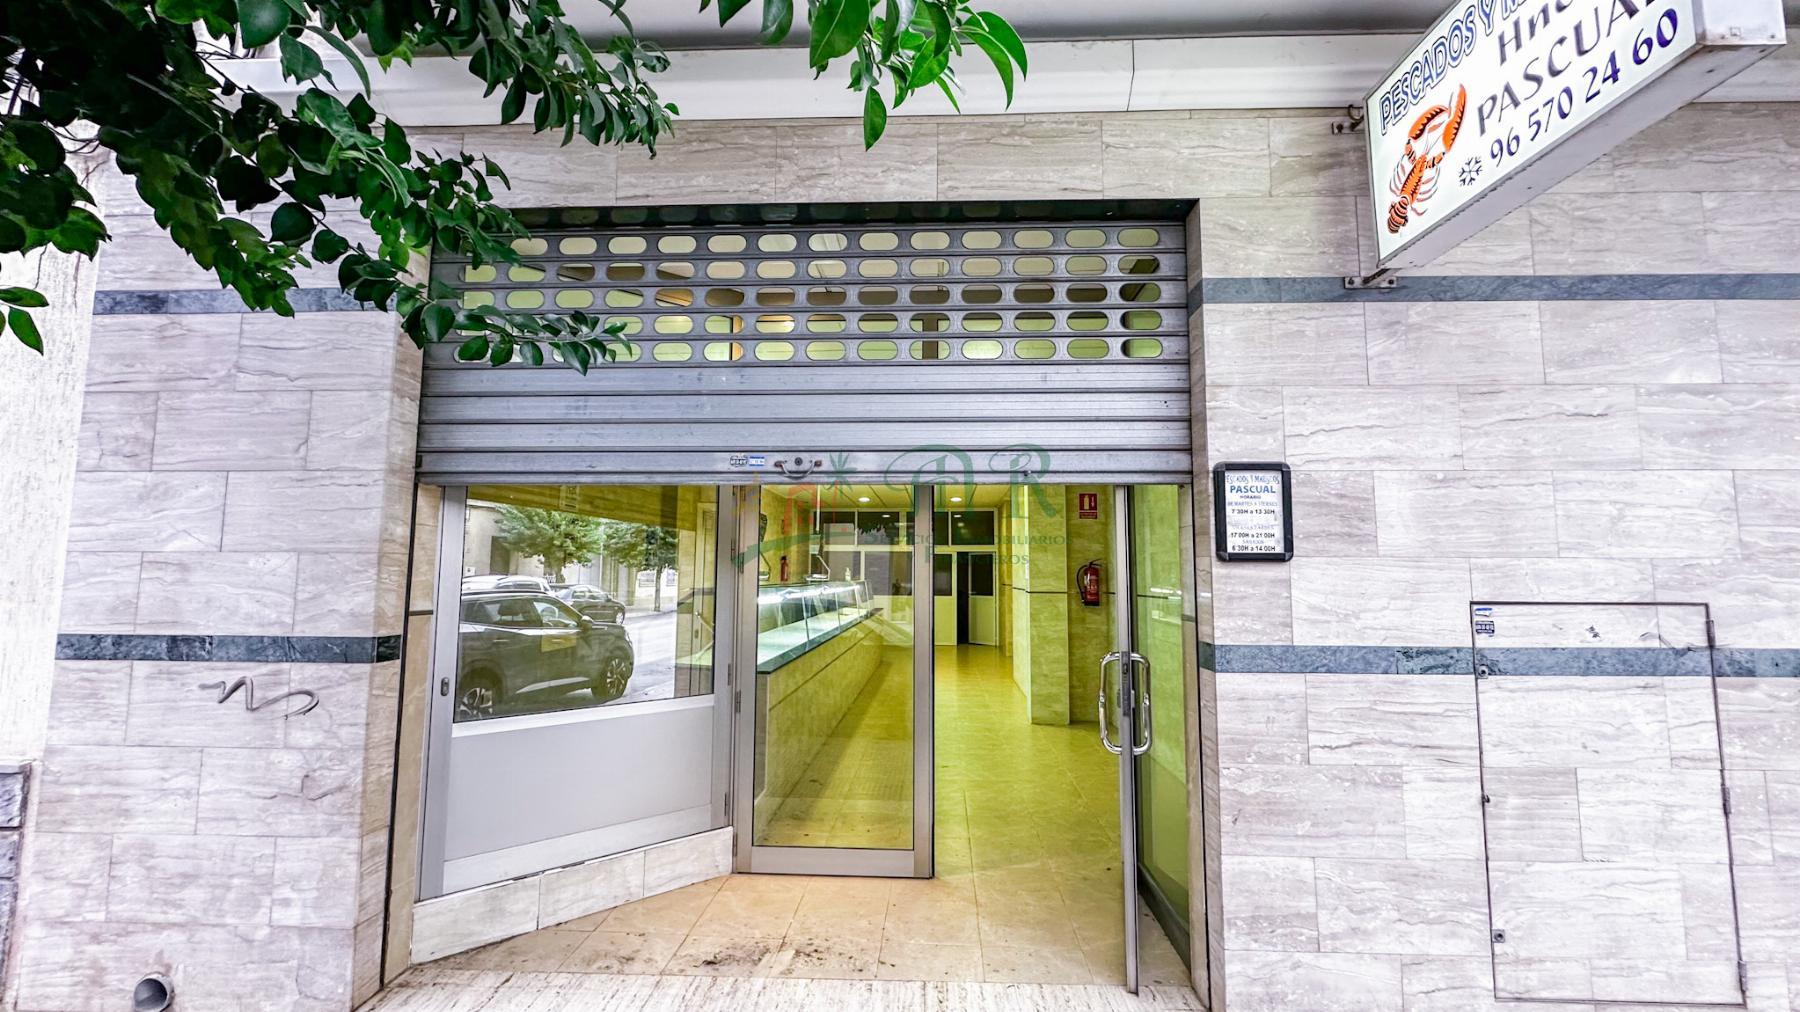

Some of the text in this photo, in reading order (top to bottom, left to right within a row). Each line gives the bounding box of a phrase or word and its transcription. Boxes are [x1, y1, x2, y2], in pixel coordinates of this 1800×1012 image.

[1379, 0, 1497, 136] PESCADOS Y
[1477, 0, 1656, 137] PASCUA
[1490, 8, 1678, 168] 96 570 24 60
[1230, 485, 1276, 494] PASCUAL
